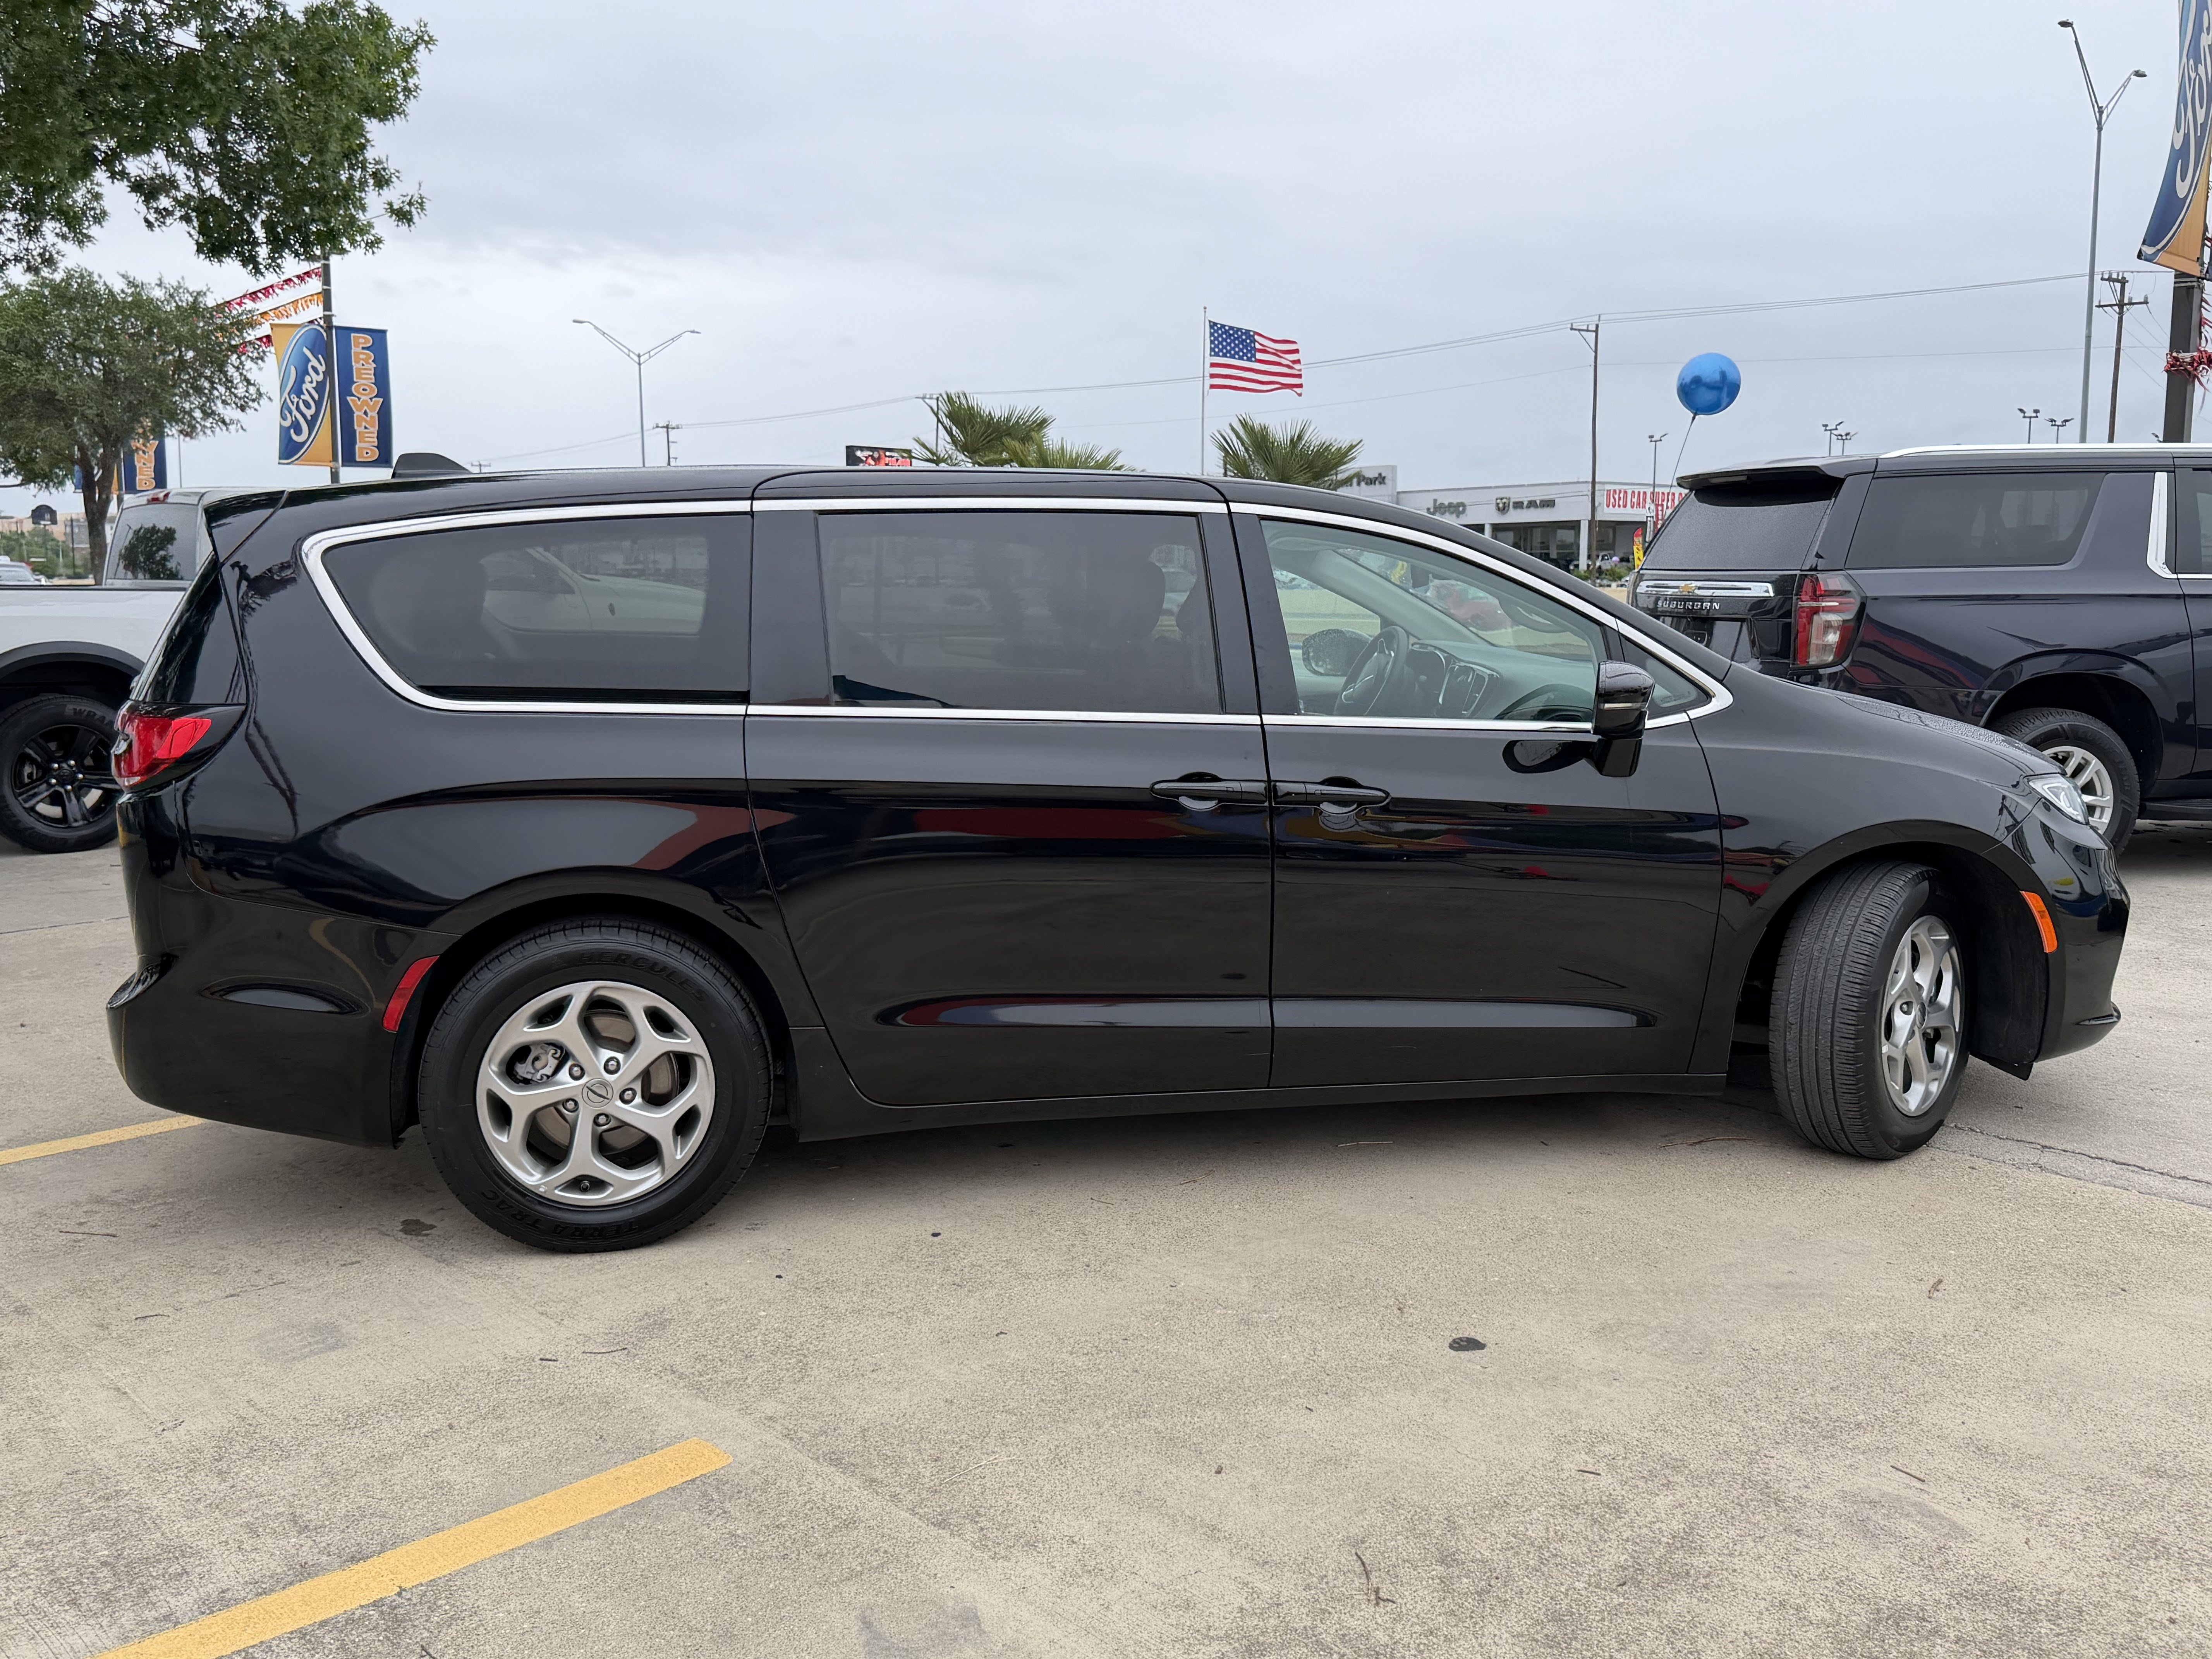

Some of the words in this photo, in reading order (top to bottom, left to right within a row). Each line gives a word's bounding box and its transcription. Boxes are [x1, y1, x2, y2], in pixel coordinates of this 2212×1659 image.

[2172, 0, 2212, 199] For
[280, 345, 326, 443] Ford
[347, 333, 383, 462] PREOWNED
[1357, 472, 1386, 487] Park
[1426, 498, 1467, 518] Jeep
[1513, 499, 1555, 509] RAM
[1606, 489, 1628, 508] USED
[1630, 490, 1647, 509] CAR
[1657, 600, 1720, 610] SUBURBAN
[577, 951, 711, 1003] HERCULES
[481, 1188, 544, 1230] TRAC
[551, 1219, 639, 1239] TERRA
